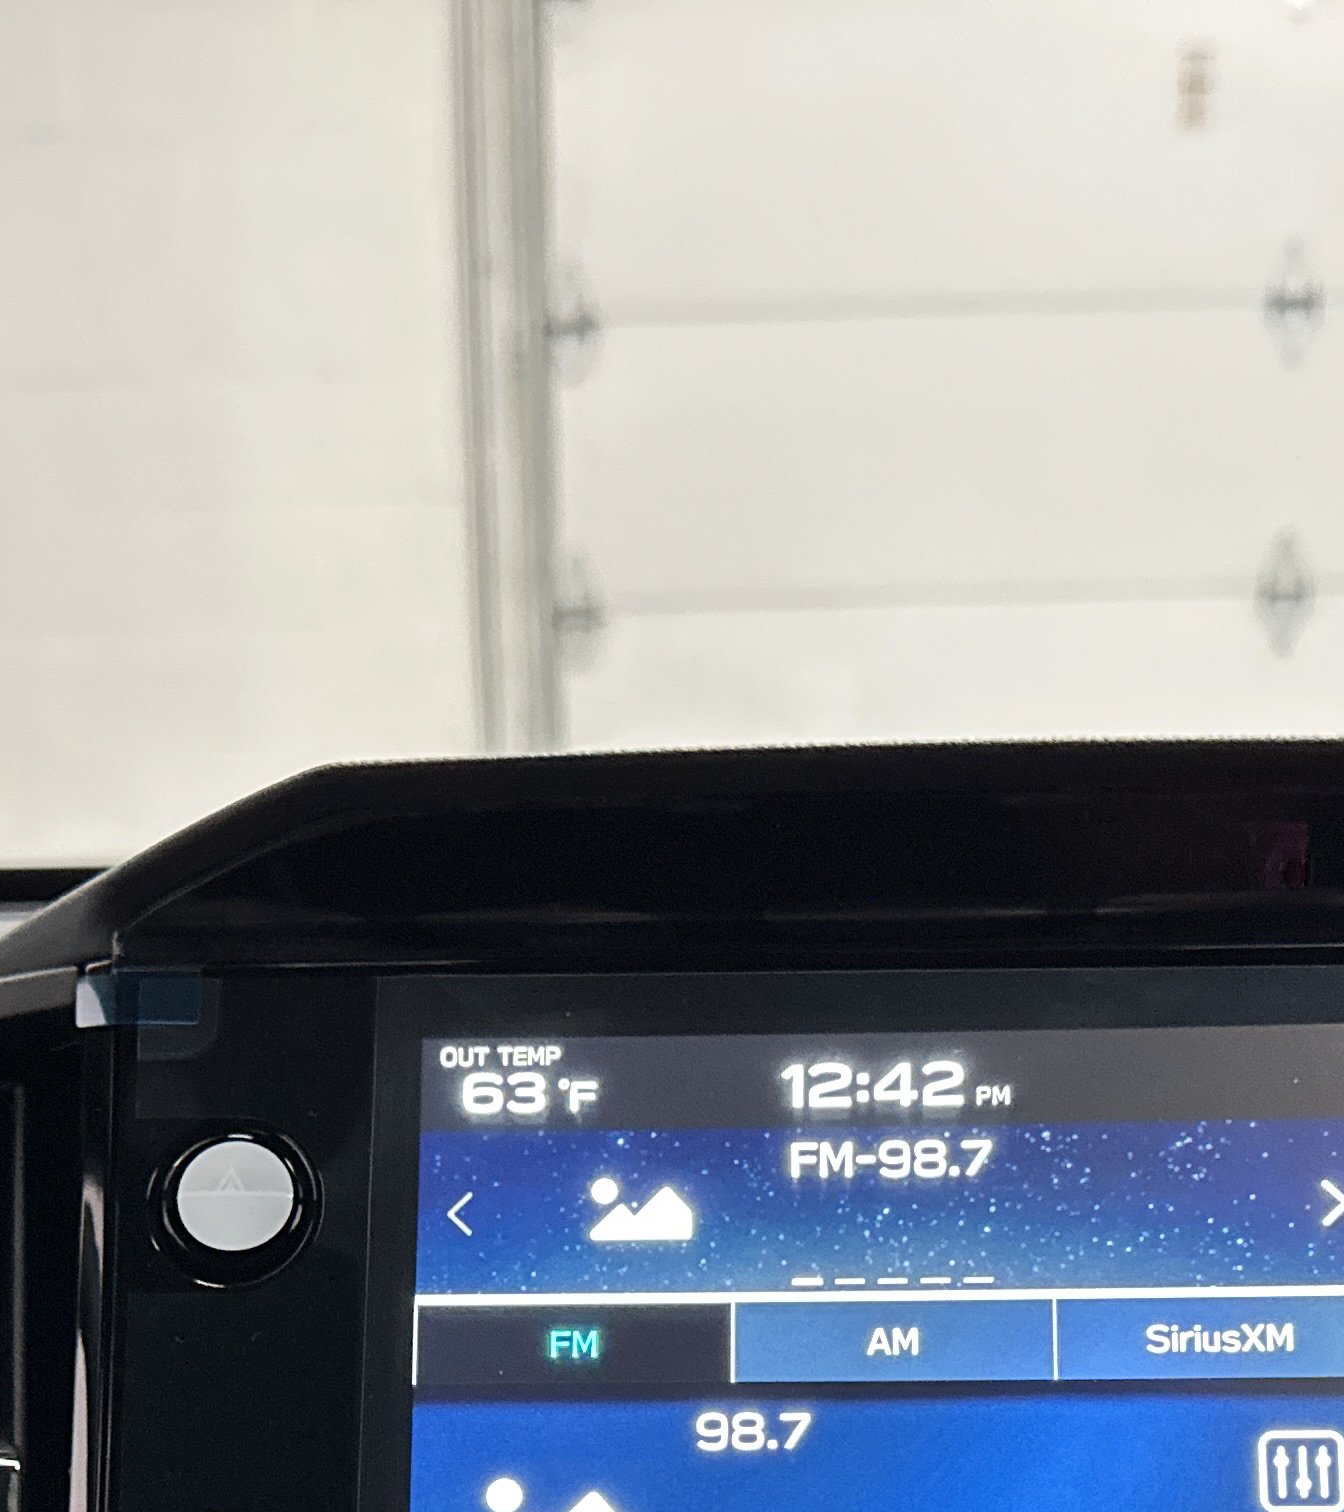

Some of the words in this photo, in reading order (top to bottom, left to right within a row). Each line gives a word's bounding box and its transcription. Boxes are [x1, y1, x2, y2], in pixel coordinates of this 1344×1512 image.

[439, 1045, 489, 1068] OUT
[497, 1044, 562, 1068] TEMP
[460, 1072, 547, 1116] 63
[781, 1060, 968, 1110] 12:42
[975, 1083, 1012, 1107] PM
[788, 1139, 994, 1180] FM-98.7
[548, 1329, 600, 1360] FM
[866, 1327, 919, 1356] AM
[1146, 1322, 1295, 1355] SiriusXM
[694, 1412, 811, 1452] 98.7
